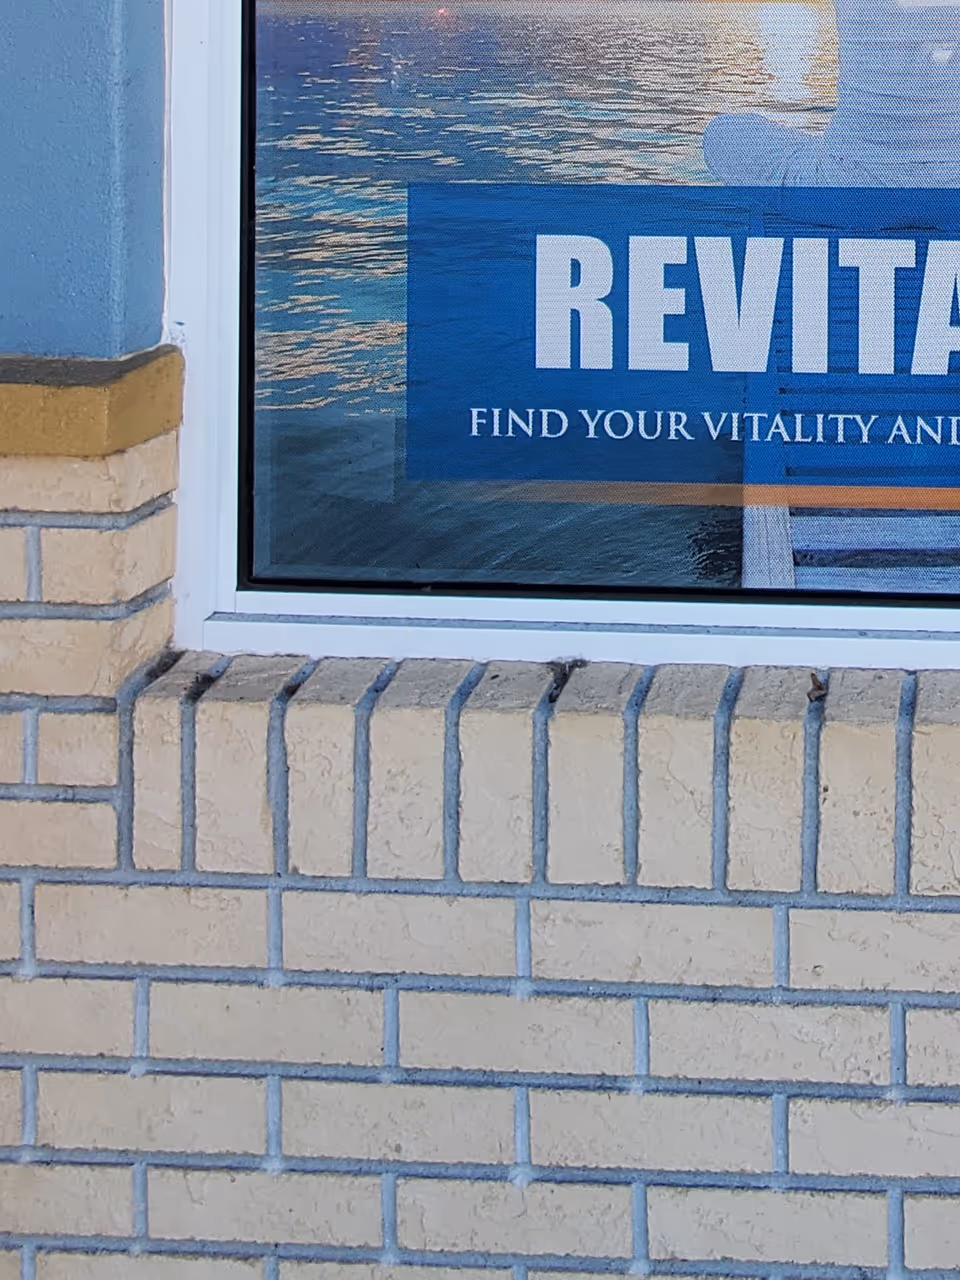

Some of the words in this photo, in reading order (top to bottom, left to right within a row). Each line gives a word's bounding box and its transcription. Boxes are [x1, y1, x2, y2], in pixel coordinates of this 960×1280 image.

[469, 407, 569, 438] FIND
[578, 409, 696, 441] YOUR
[701, 411, 880, 444] VITALITY
